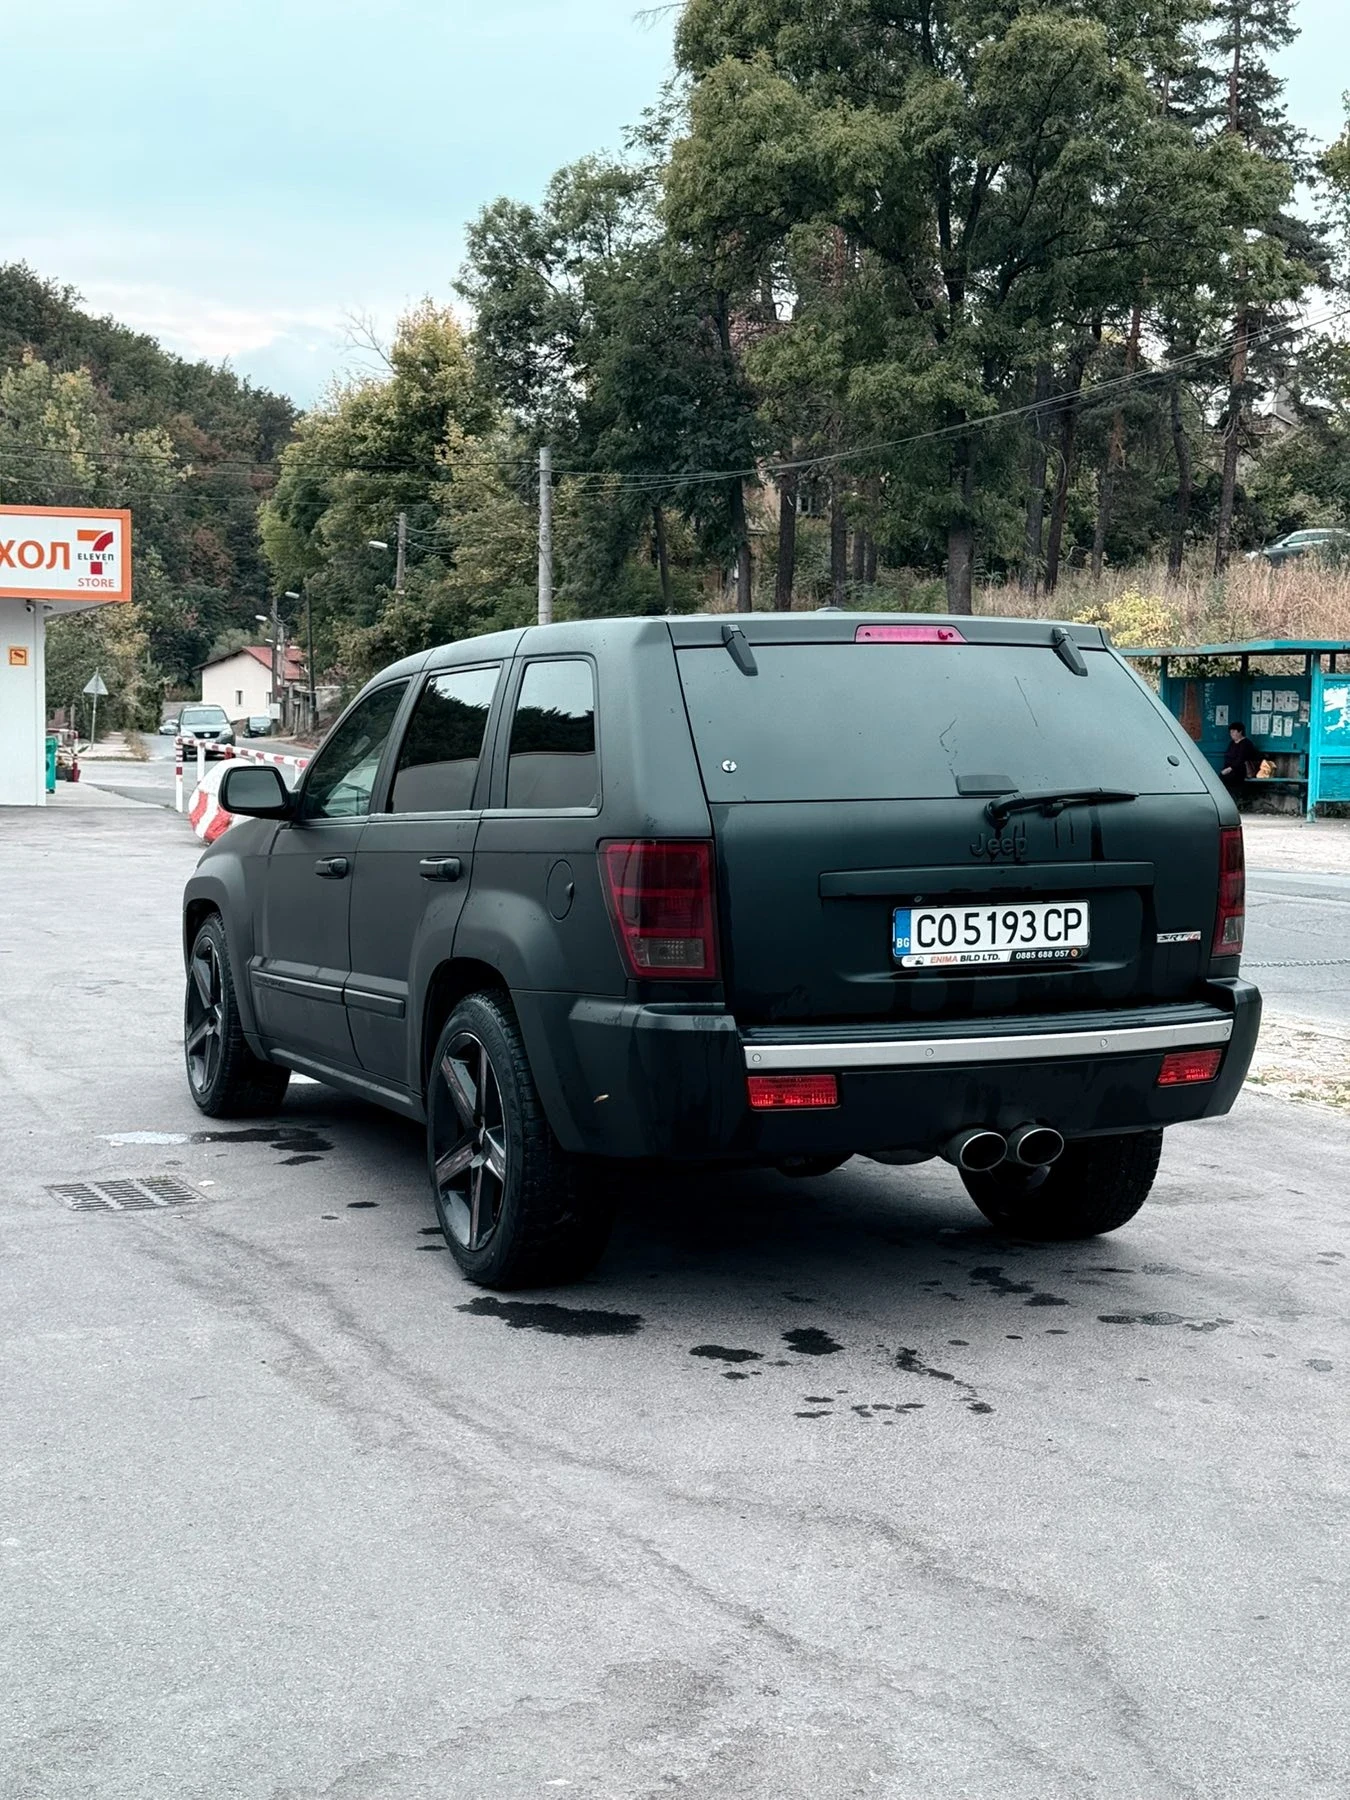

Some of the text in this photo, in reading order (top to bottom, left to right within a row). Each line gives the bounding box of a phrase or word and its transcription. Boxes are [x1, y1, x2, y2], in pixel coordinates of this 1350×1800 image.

[77, 577, 114, 588] STORE
[969, 832, 1028, 859] Jeep
[896, 937, 910, 948] BG
[930, 953, 1001, 964] ENIMA BILD LTD.
[1055, 949, 1070, 958] 057
